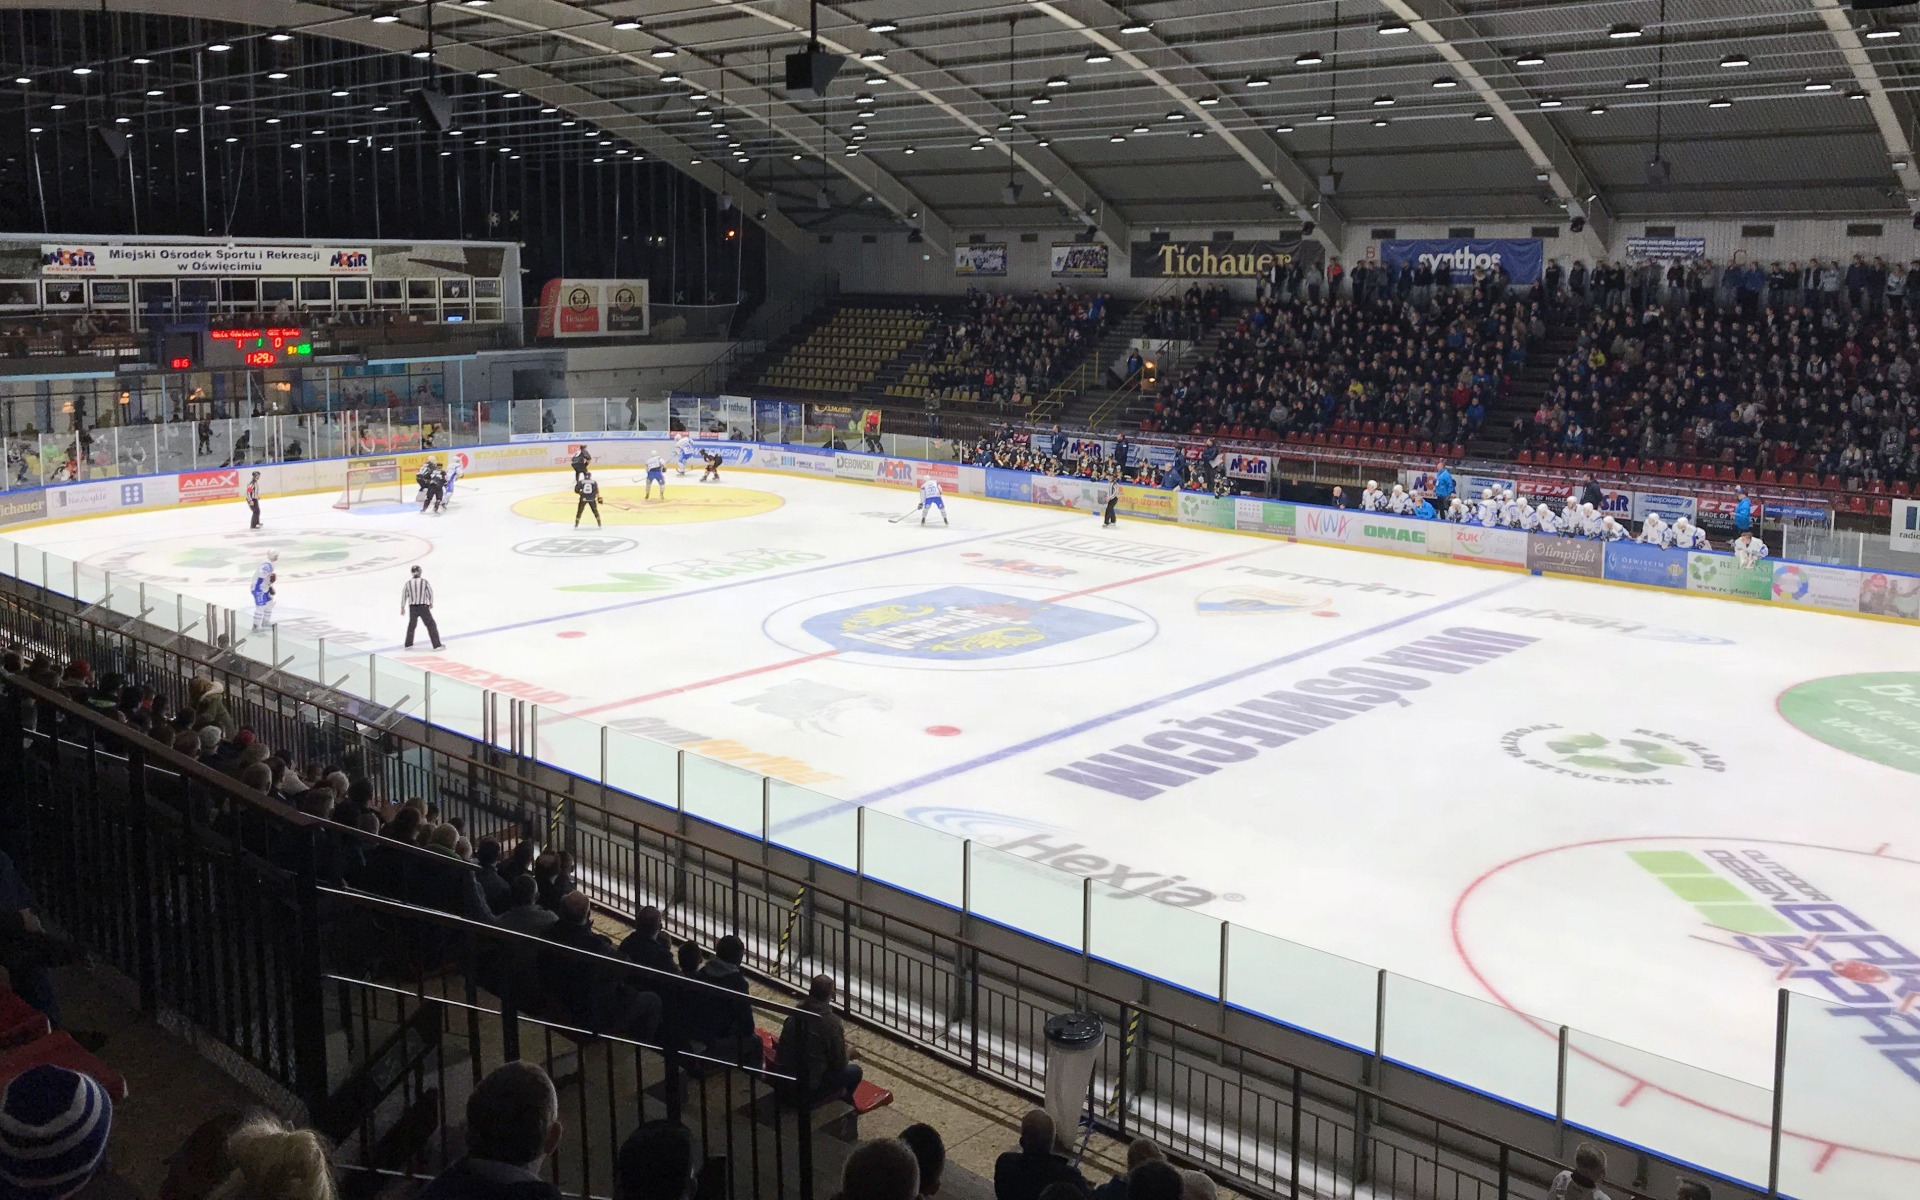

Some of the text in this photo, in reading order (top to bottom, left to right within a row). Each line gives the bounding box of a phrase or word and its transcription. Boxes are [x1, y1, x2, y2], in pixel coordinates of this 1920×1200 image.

[109, 249, 155, 261] Miejski
[160, 249, 211, 259] Ośrodek
[216, 250, 255, 260] Sportu
[266, 250, 320, 262] Rekreacji
[192, 261, 262, 272] Oświęcimiu
[1159, 244, 1292, 276] Tichauer
[1418, 245, 1501, 275] synthos
[183, 471, 237, 488] AMAX
[1519, 483, 1570, 495] CCM
[0, 500, 45, 516] ichauer
[1698, 511, 1718, 519] MADE
[1363, 524, 1426, 544] OMAG
[1456, 531, 1478, 542] ZUK
[1016, 532, 1200, 563] PACIFIC
[1533, 541, 1596, 565] Olimpijski
[1362, 626, 1542, 674] UNIA
[1044, 666, 1433, 801] OŚWIĘCIM
[1702, 849, 1800, 902] DESIGN
[1740, 849, 1835, 901] OUTDOOR
